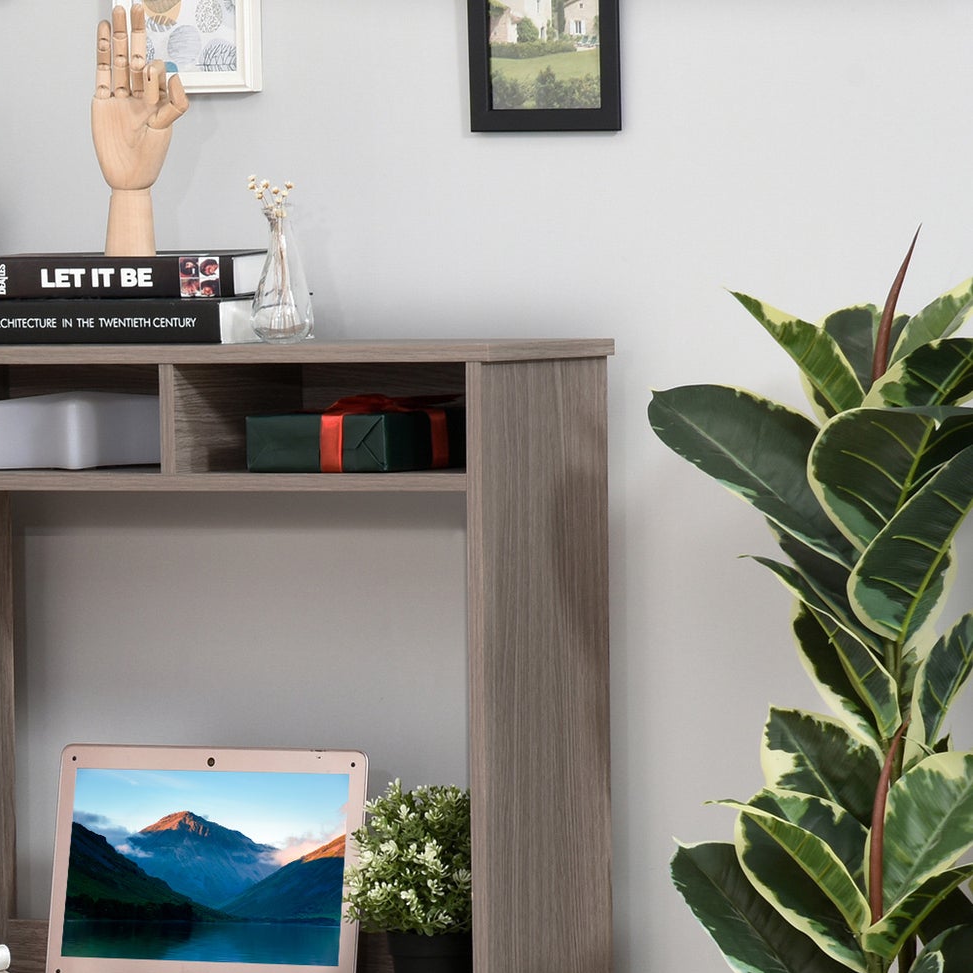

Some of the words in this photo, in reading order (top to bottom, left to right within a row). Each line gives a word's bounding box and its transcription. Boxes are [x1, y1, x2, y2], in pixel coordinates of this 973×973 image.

[40, 268, 86, 288] LET
[91, 268, 115, 287] IT
[120, 268, 153, 287] BE
[62, 318, 73, 328] IN
[76, 318, 95, 328] THE
[98, 317, 151, 328] TWENTIETH
[152, 317, 197, 327] CENTURY
